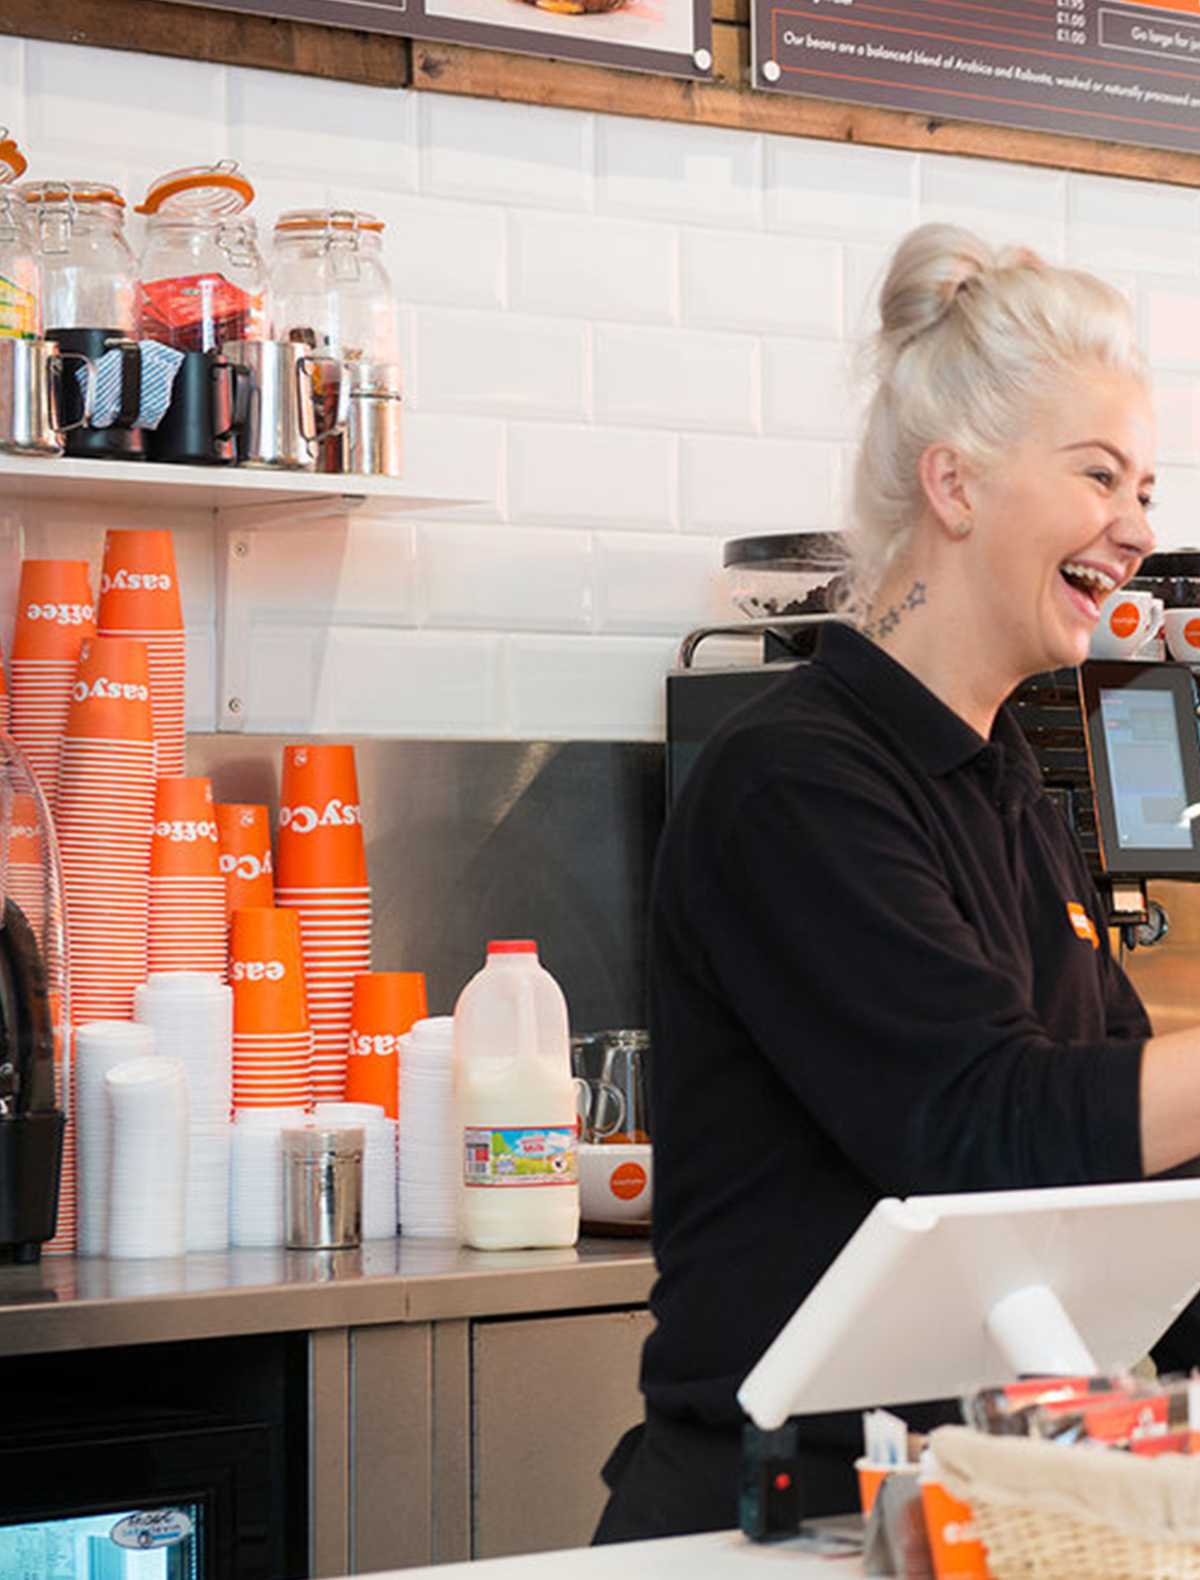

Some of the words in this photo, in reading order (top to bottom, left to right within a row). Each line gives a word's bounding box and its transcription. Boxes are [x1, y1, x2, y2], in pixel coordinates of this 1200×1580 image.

[1056, 11, 1087, 28] £1.00
[1056, 28, 1087, 45] £1.00
[1131, 26, 1148, 41] Go
[1148, 28, 1173, 48] large
[1174, 31, 1189, 48] for
[783, 30, 803, 45] Our
[806, 33, 837, 51] beans
[838, 42, 855, 54] are
[856, 44, 865, 56] a
[866, 43, 913, 63] balanced
[914, 51, 942, 67] blend
[943, 56, 954, 69] of
[954, 58, 993, 76] Arabica
[994, 65, 1014, 79] and
[1055, 75, 1092, 91] washed
[1092, 82, 1103, 92] or
[1104, 84, 1143, 103] naturally
[1144, 91, 1190, 107] processed
[27, 603, 97, 625] offee
[231, 960, 286, 982] eas
